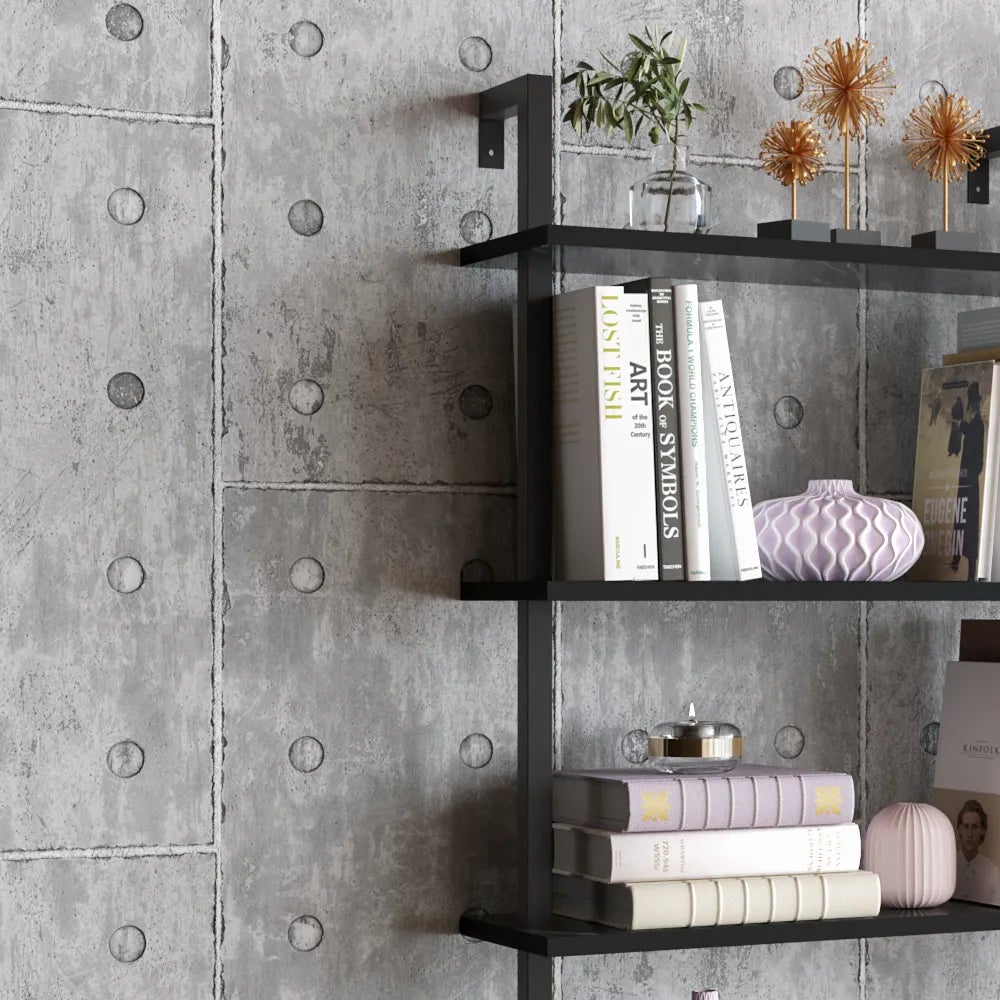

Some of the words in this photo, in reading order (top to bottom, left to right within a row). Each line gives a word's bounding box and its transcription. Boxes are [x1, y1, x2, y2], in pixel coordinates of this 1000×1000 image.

[600, 295, 620, 359] LOST
[655, 323, 664, 345] THE
[685, 300, 694, 345] FORMULA
[603, 366, 623, 419] FISH
[629, 361, 648, 406] ART
[656, 349, 674, 410] BOOK
[687, 356, 696, 390] WORLD
[630, 431, 651, 439] Century
[658, 414, 668, 428] OF
[689, 392, 699, 448] CHAMPIONS
[719, 372, 748, 507] ANTIQUAIRES
[659, 432, 680, 539] SYMBOLS
[924, 497, 968, 525] EUGENE
[963, 745, 1000, 755] KINFOLK
